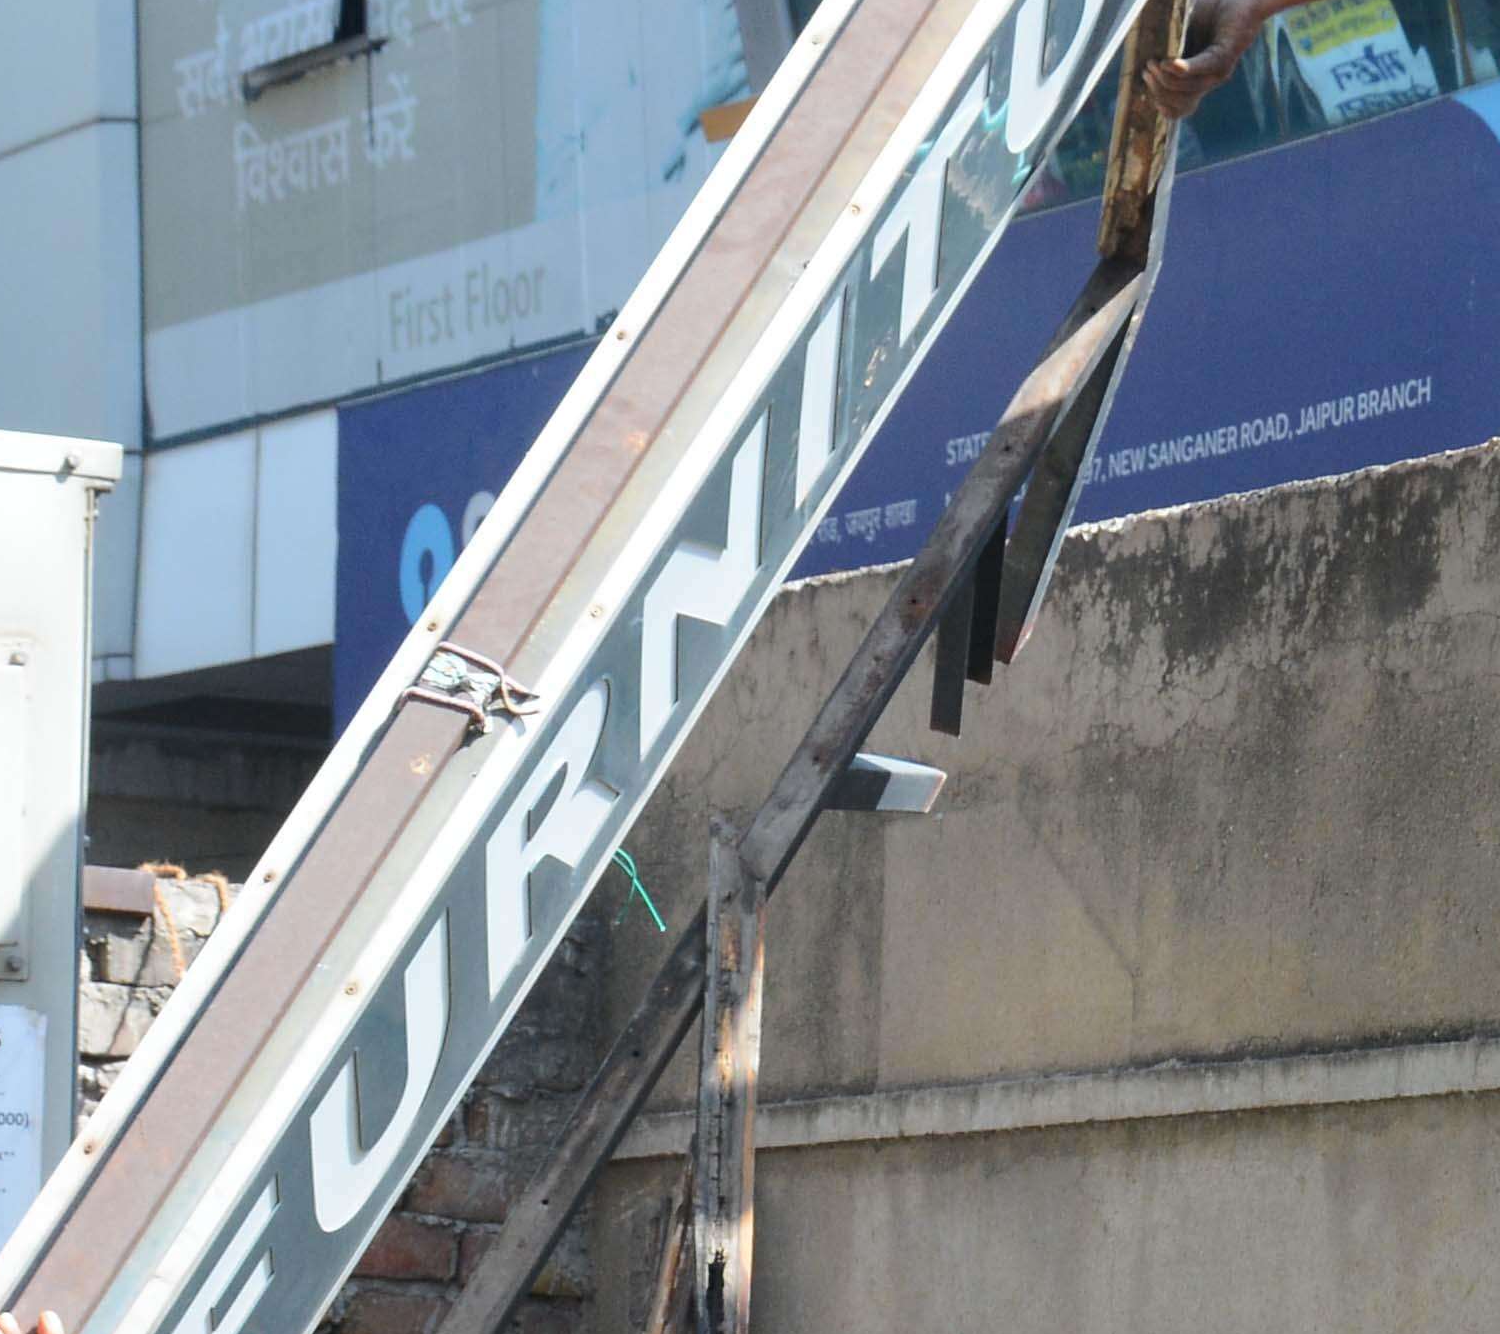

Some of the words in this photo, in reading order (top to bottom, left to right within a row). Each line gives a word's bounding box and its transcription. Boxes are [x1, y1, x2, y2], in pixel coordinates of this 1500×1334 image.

[389, 280, 453, 351] First
[464, 263, 545, 333] Floor
[1108, 443, 1148, 479] NEW
[1148, 425, 1237, 469] SANGANER
[1240, 413, 1293, 447] ROAD,
[1295, 398, 1354, 436] JAIPUR
[1357, 376, 1431, 421] BRANCH
